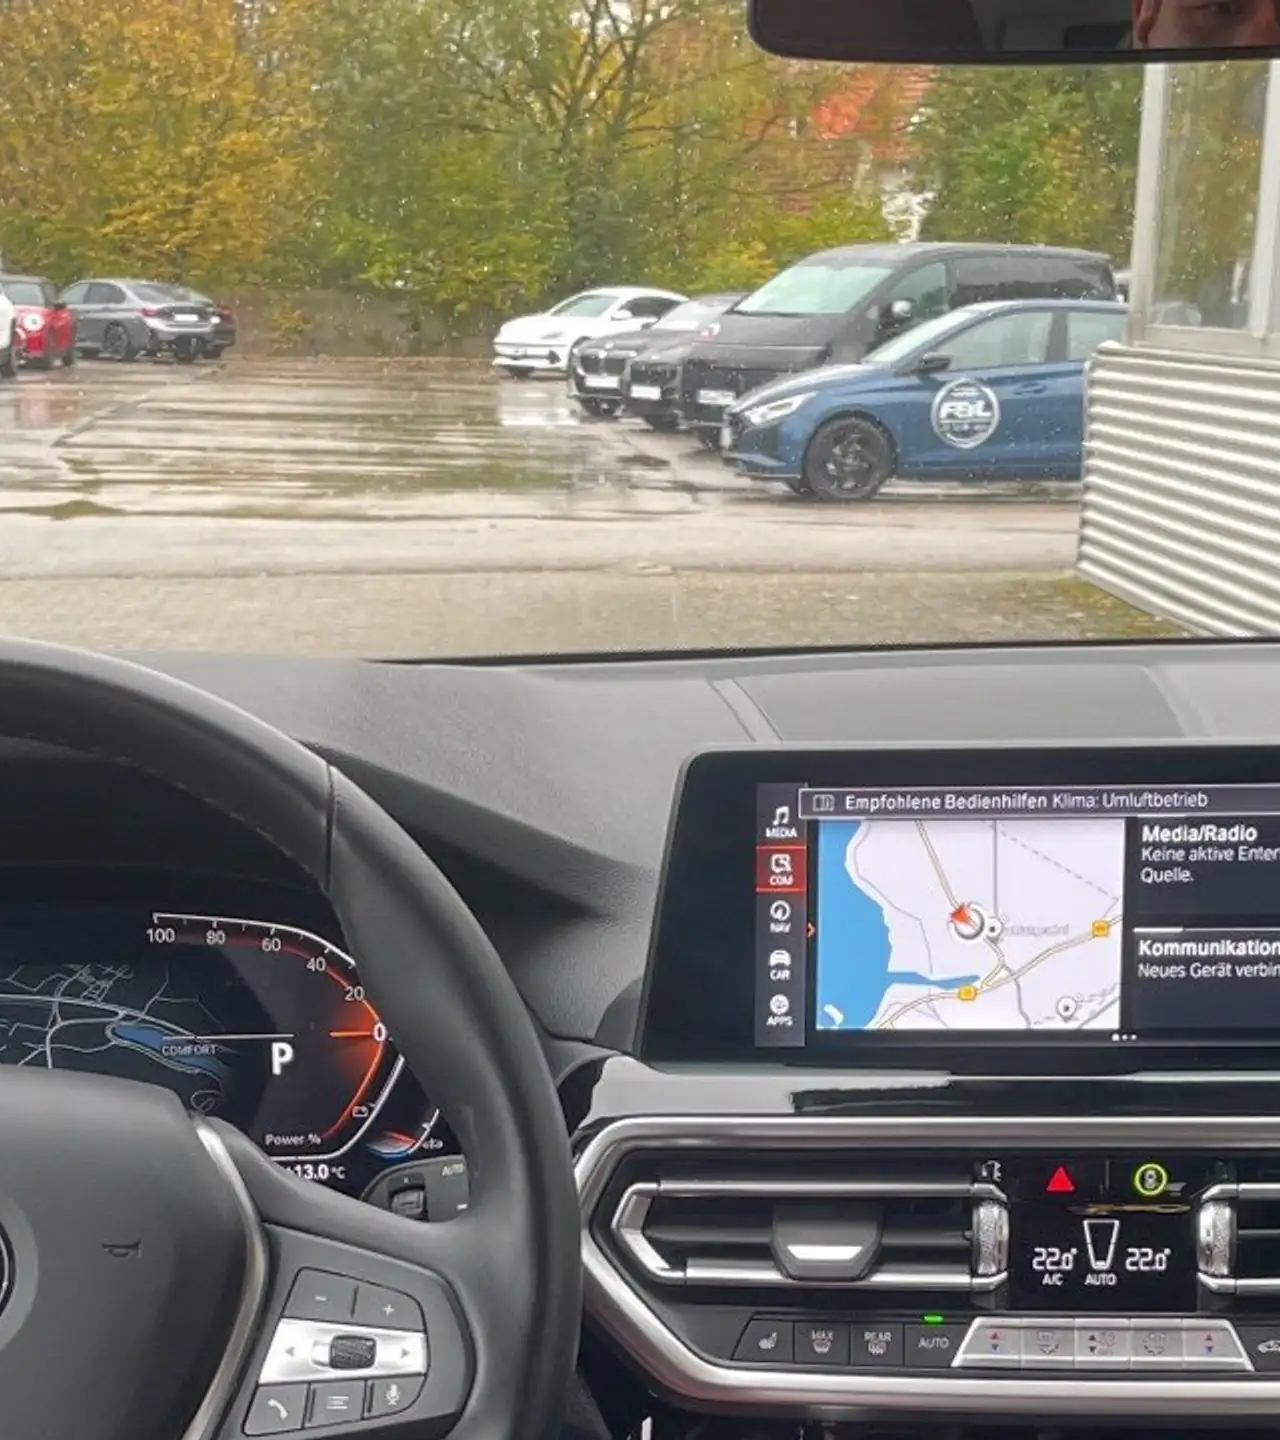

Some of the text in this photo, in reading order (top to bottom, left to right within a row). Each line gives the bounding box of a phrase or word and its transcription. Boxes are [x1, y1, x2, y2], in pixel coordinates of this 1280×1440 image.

[845, 790, 1209, 812] Empfohlene Bedienhilfen Klima: Umluftbetrieb
[766, 827, 798, 838] MEDIA
[1141, 825, 1259, 843] Media/Radio
[1141, 847, 1186, 862] Keine
[1188, 846, 1235, 862] aktive
[769, 874, 794, 886] COM
[1140, 867, 1194, 885] Quelle.
[769, 922, 791, 933] NAV
[146, 928, 176, 944] 100
[206, 930, 226, 946] 80
[261, 936, 282, 952] 60
[306, 956, 327, 973] 40
[1137, 964, 1187, 978] Neues
[1189, 962, 1232, 978] Gerät
[769, 970, 791, 981] CAR
[344, 985, 365, 1003] 20
[766, 1014, 793, 1027] APPS
[373, 1023, 387, 1043] 0
[161, 1043, 217, 1056] COMFORT
[271, 1041, 294, 1075] P
[264, 1133, 321, 1146] Power %
[331, 1164, 346, 1180] °C
[1041, 1273, 1064, 1287] A/C
[1083, 1273, 1117, 1287] AUTO
[918, 1336, 949, 1349] AUTO
